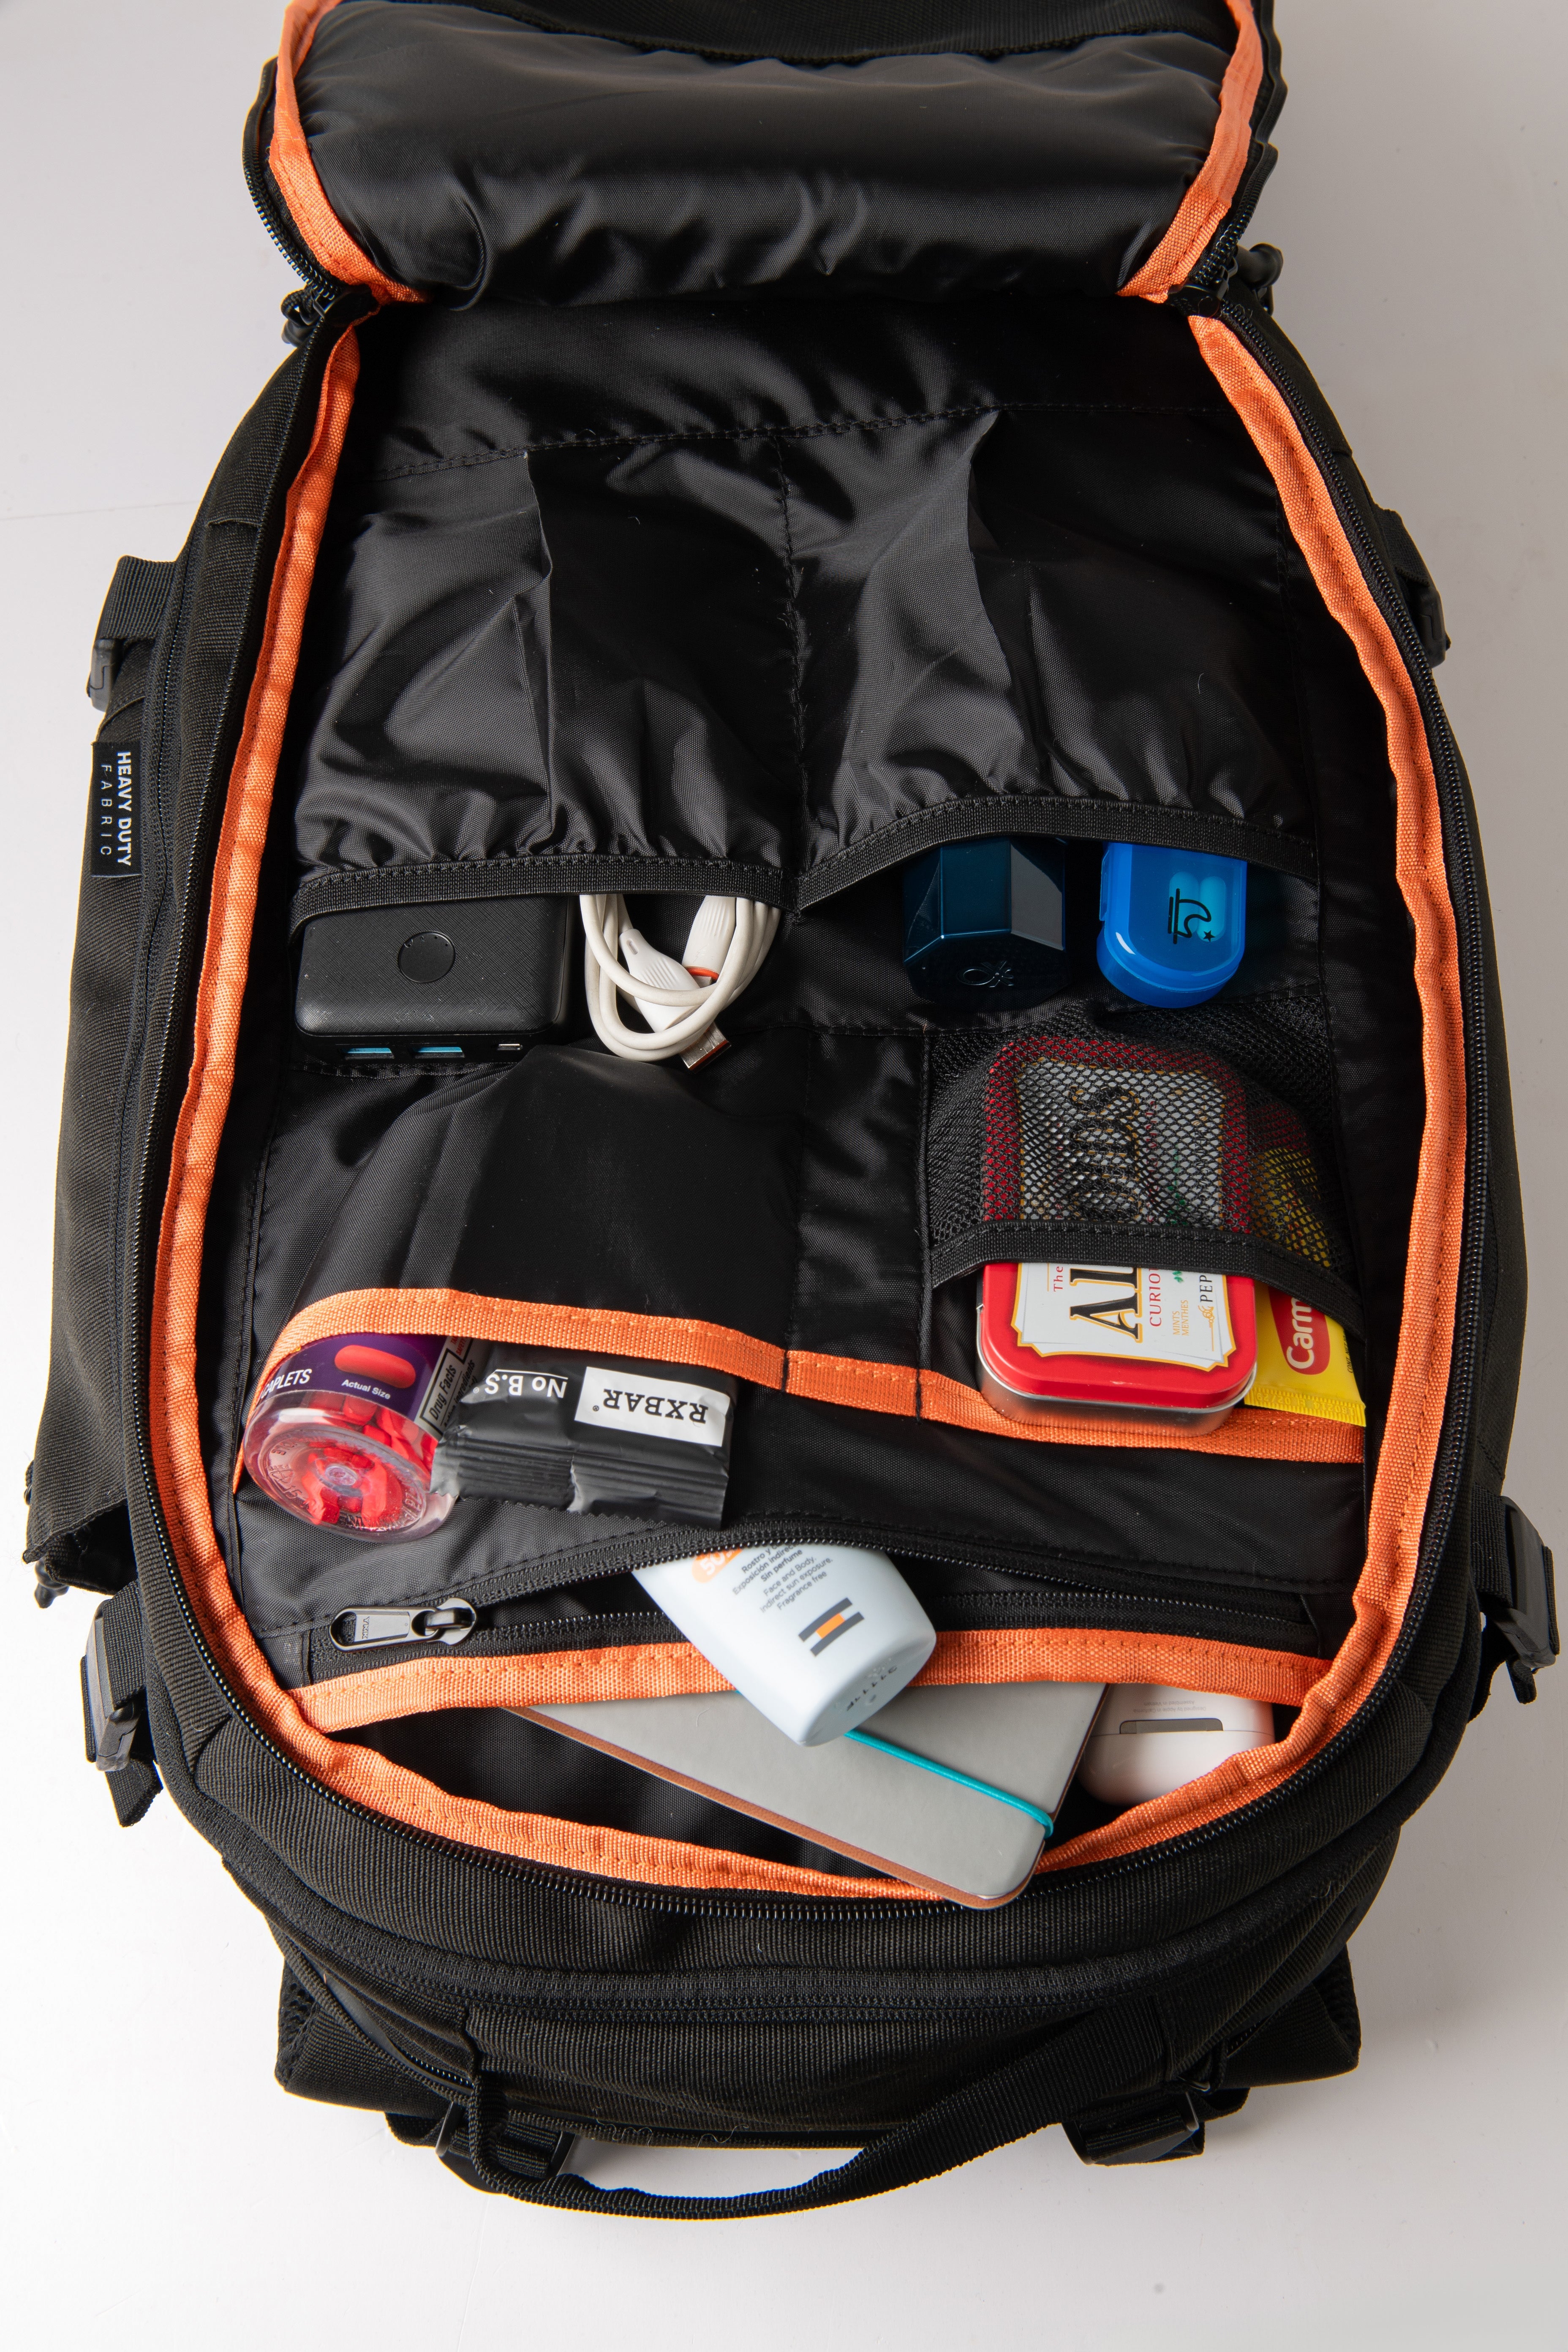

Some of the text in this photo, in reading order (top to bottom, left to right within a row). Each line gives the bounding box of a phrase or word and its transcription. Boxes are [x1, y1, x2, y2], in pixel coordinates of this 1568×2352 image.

[100, 764, 112, 855] FABRIC
[117, 751, 132, 866] HEAVY DUTY
[1054, 1266, 1064, 1292] The
[1181, 1299, 1190, 1336] MENTHES
[342, 1380, 391, 1399] Actual Size
[429, 1364, 457, 1421] Drug Facts
[532, 1376, 567, 1398] No
[732, 1544, 794, 1596] Exposición indirec
[741, 1553, 765, 1573] Rostro
[761, 1549, 803, 1582] Sin perfume
[763, 1556, 817, 1597] Face and Body.
[760, 1557, 833, 1614] Indirect sun exposure.
[776, 1570, 828, 1611] Fragrance free
[362, 1616, 370, 1639] YKK
